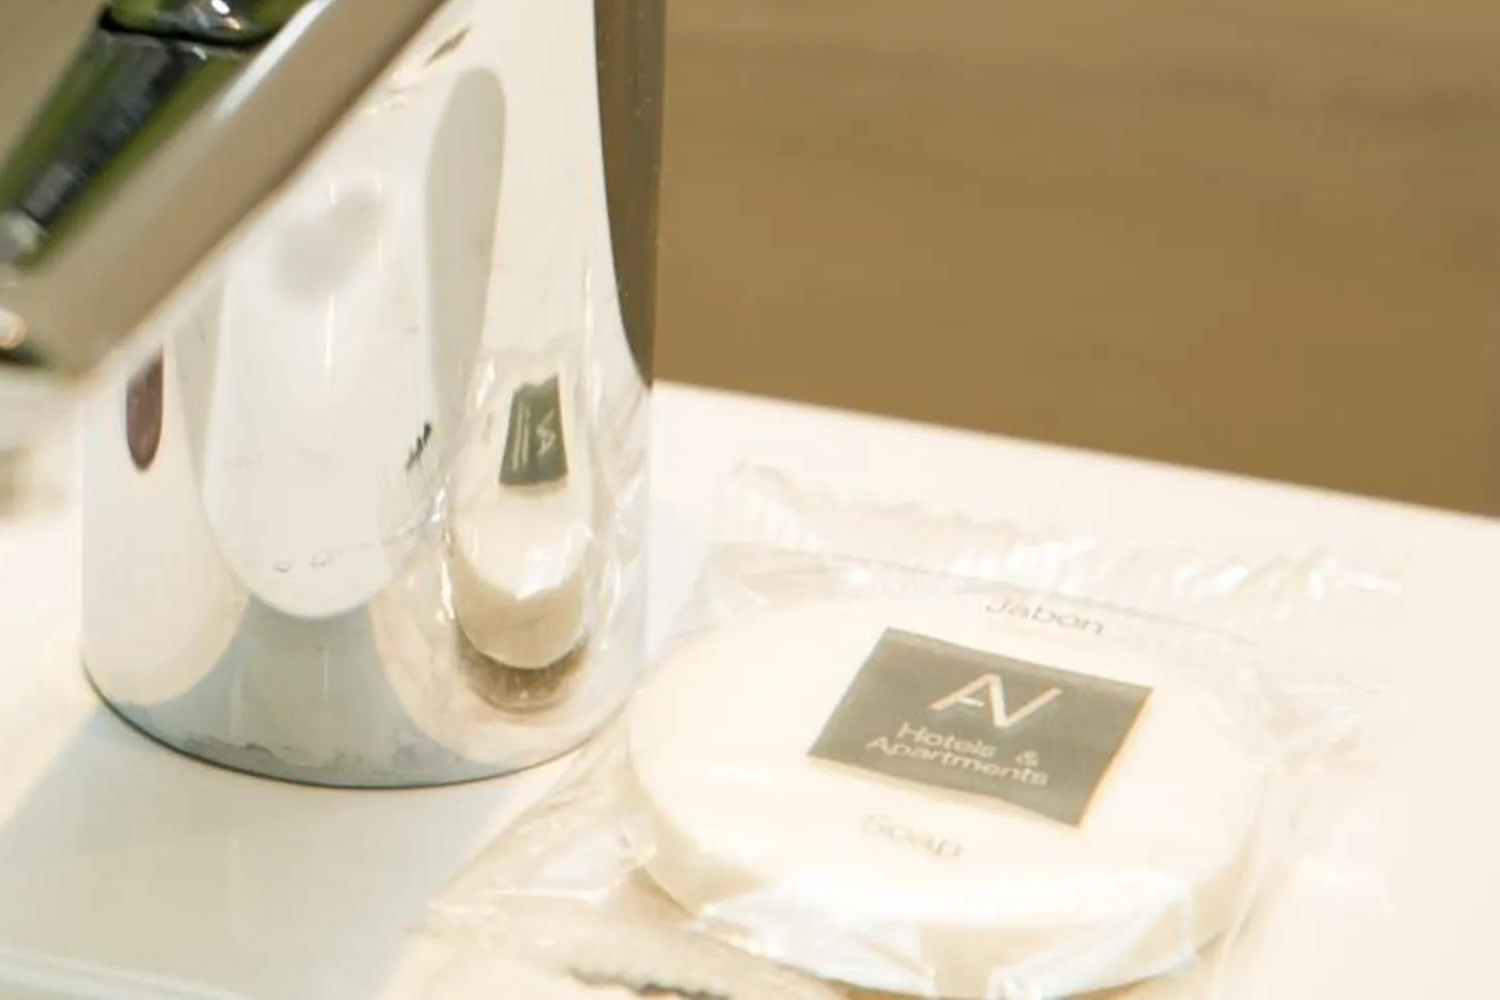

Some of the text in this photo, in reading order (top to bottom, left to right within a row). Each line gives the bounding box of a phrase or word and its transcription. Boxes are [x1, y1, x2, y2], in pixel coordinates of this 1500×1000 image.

[930, 672, 1064, 728] AV
[865, 735, 1050, 787] Apartments
[896, 720, 1040, 768] Hotels &
[861, 812, 964, 860] Soap
